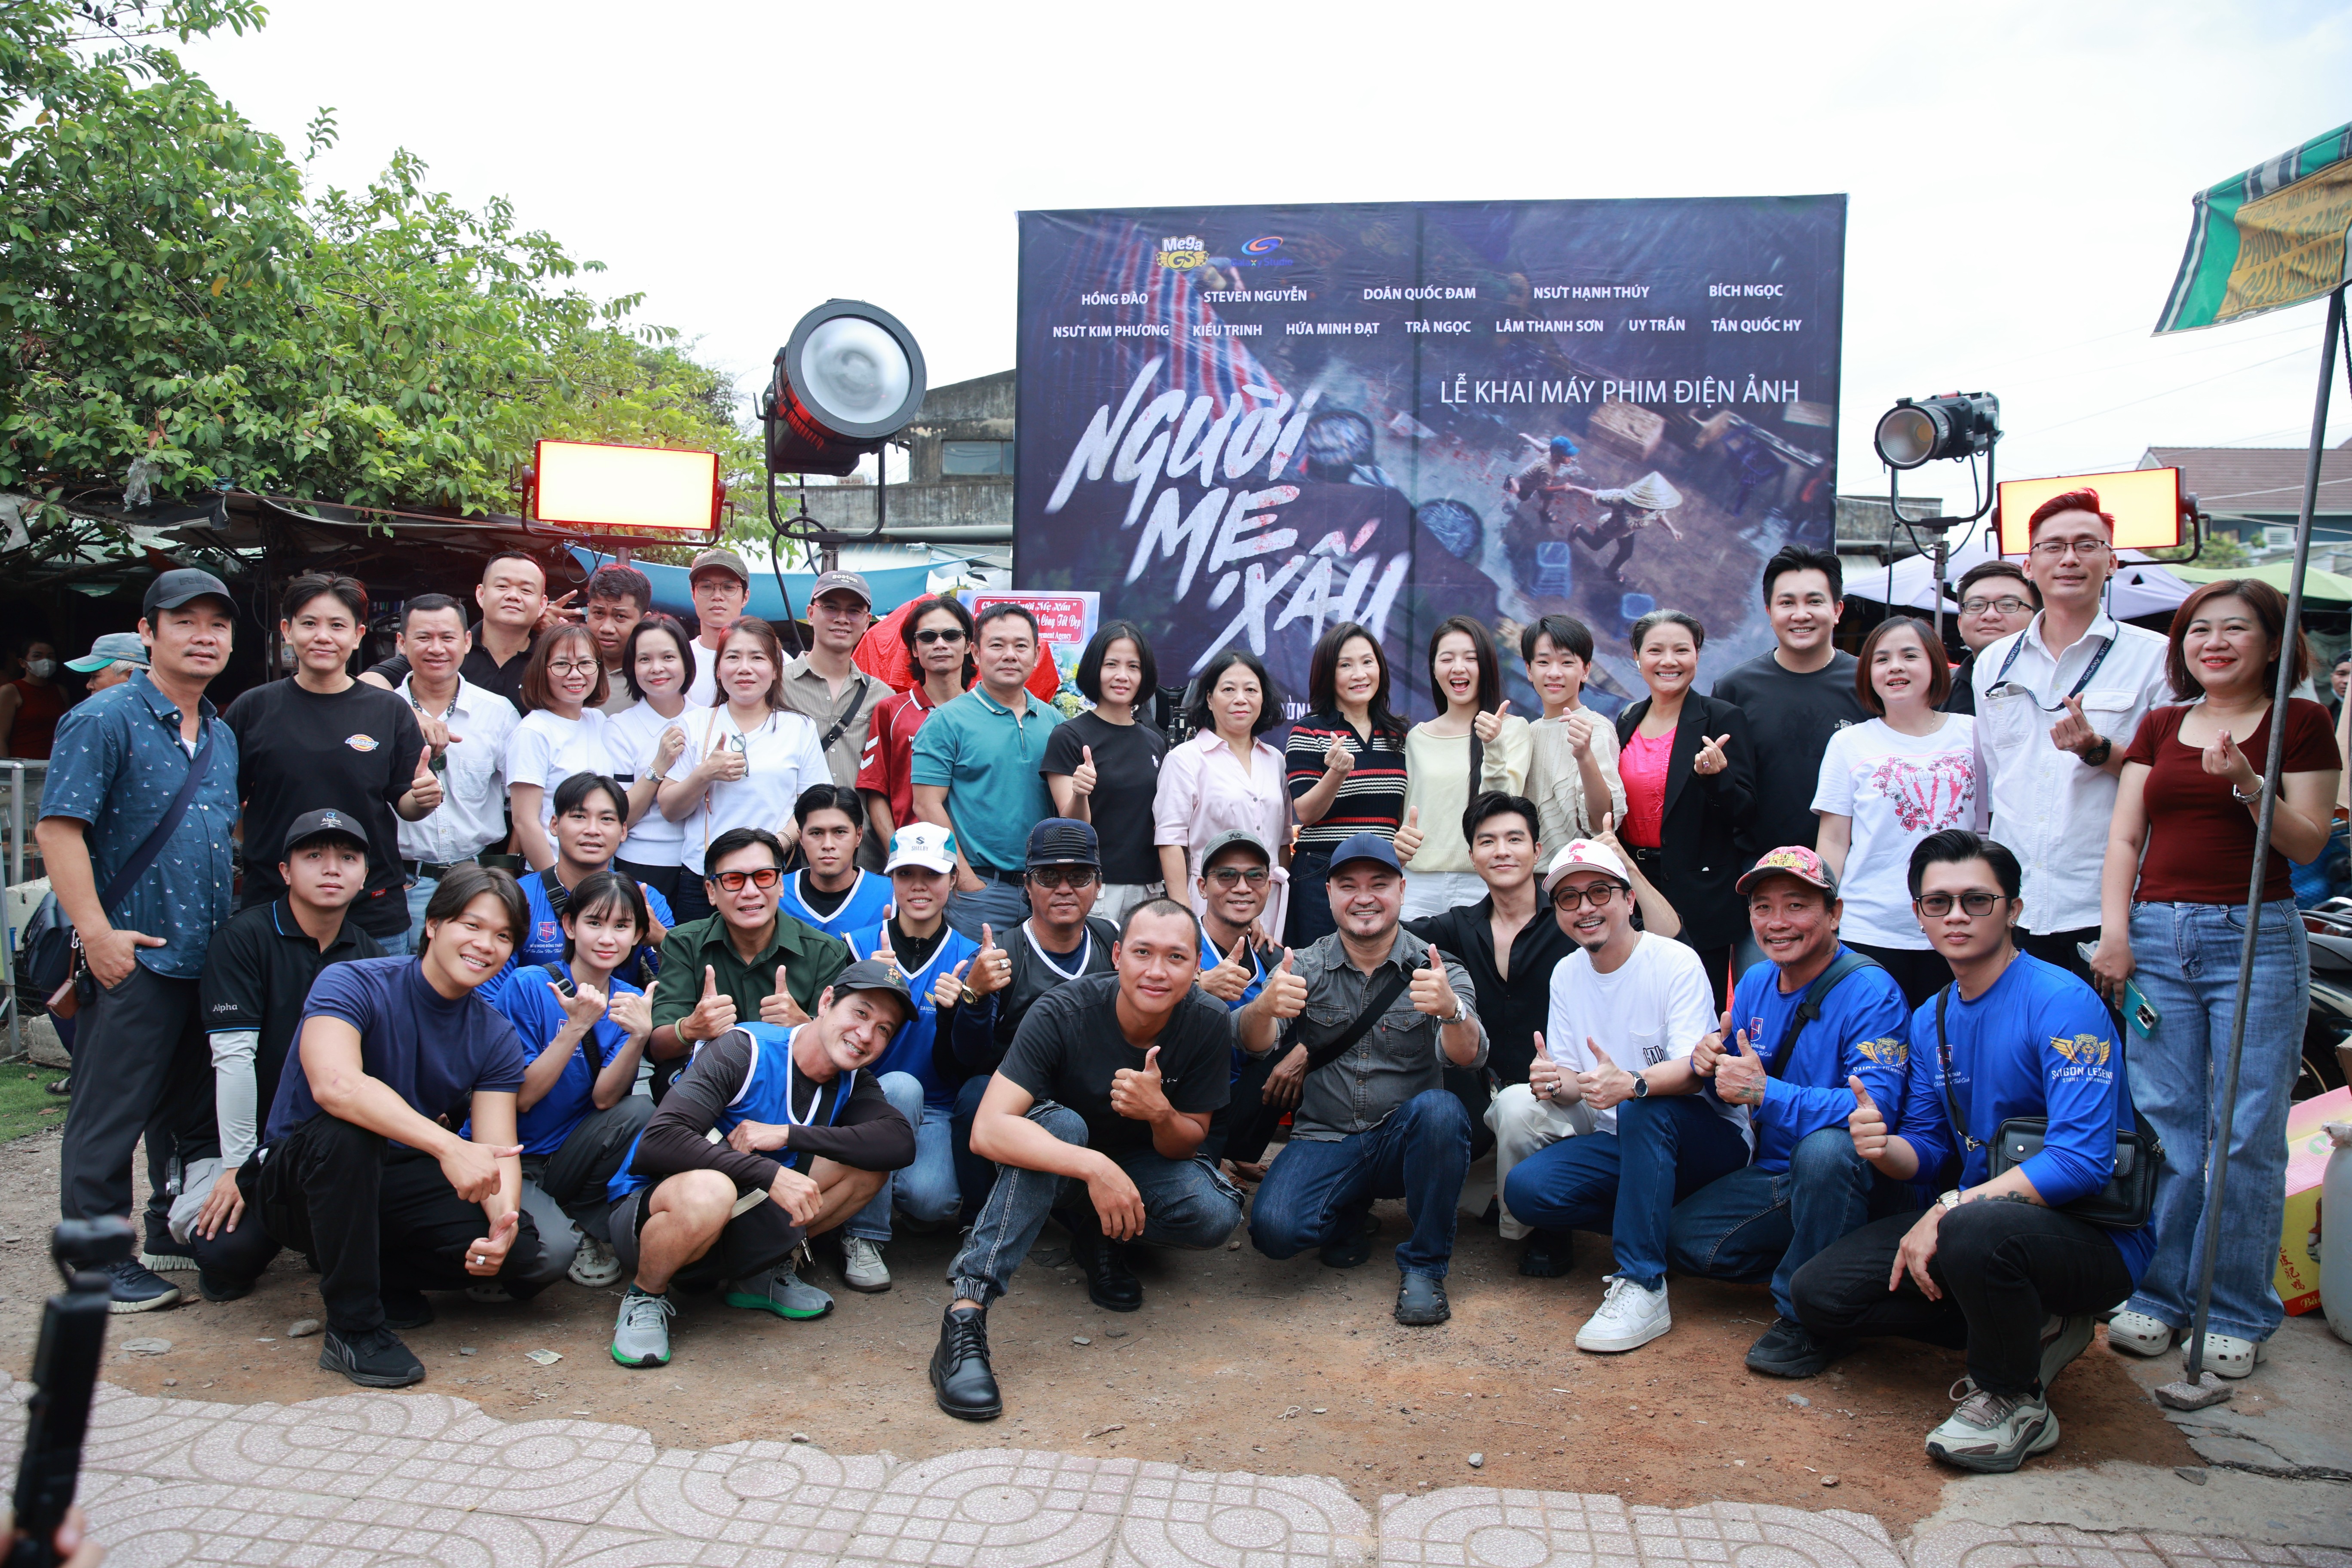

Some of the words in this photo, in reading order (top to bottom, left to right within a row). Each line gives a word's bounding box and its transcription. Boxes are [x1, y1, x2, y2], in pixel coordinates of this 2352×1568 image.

[1163, 236, 1204, 252] Mega
[1167, 251, 1196, 269] GS
[1231, 258, 1262, 268] Galaxy
[1264, 258, 1293, 267] Studio
[1082, 291, 1118, 305] HỒNG
[1121, 291, 1148, 304] ĐÀO
[1203, 291, 1251, 303] STEVEN
[1254, 286, 1307, 302] NGUYỄN
[1363, 286, 1402, 300] DOÃN
[1404, 285, 1442, 300] QUỐC
[1445, 287, 1476, 299] ĐAM
[1534, 285, 1570, 299] NSƯT
[1572, 287, 1611, 302] HẠNH
[1613, 284, 1650, 299] THÚY
[1709, 282, 1741, 297] BÍCH
[1743, 285, 1783, 300] NGỌC
[1053, 325, 1086, 337] NSƯT
[1089, 326, 1112, 337] KIM
[1115, 324, 1169, 337] PHƯƠNG
[1193, 322, 1221, 337] KIỀU
[1224, 325, 1262, 337] TRINH
[1286, 321, 1314, 335] HỨA
[1317, 323, 1351, 335] MINH
[1354, 322, 1380, 337] ĐẠT
[1405, 319, 1430, 333] TRÀ
[1433, 321, 1471, 336] NGỌC
[1496, 318, 1524, 332] LÂM
[1526, 320, 1574, 332] THANH
[1576, 319, 1604, 332] SƠN
[1629, 319, 1648, 331] UY
[1649, 316, 1685, 331] TRẦN
[1711, 318, 1737, 332] TÂN
[1740, 316, 1780, 333] QUỐC
[1783, 319, 1802, 331] HY
[1441, 373, 1467, 404] LỄ
[1476, 381, 1533, 403] KHAI
[1541, 376, 1596, 403] MÁY
[1602, 380, 1667, 403] PHIM
[1673, 376, 1735, 409] ĐIỆN
[1743, 373, 1799, 403] ẢNH
[1044, 356, 1320, 530] NGƯỜI
[832, 574, 858, 583] Boston
[1035, 602, 1052, 612] Mẹ
[1052, 602, 1071, 611] Xấu
[1041, 614, 1056, 629] Công
[1069, 615, 1081, 630] Đẹp
[1055, 631, 1072, 641] Agency
[2006, 645, 2020, 665] STUDIO
[2083, 658, 2100, 680] GALAXY
[1768, 853, 1796, 862] TRUE
[213, 1003, 238, 1013] Alpha
[1643, 1045, 1664, 1066] GAP
